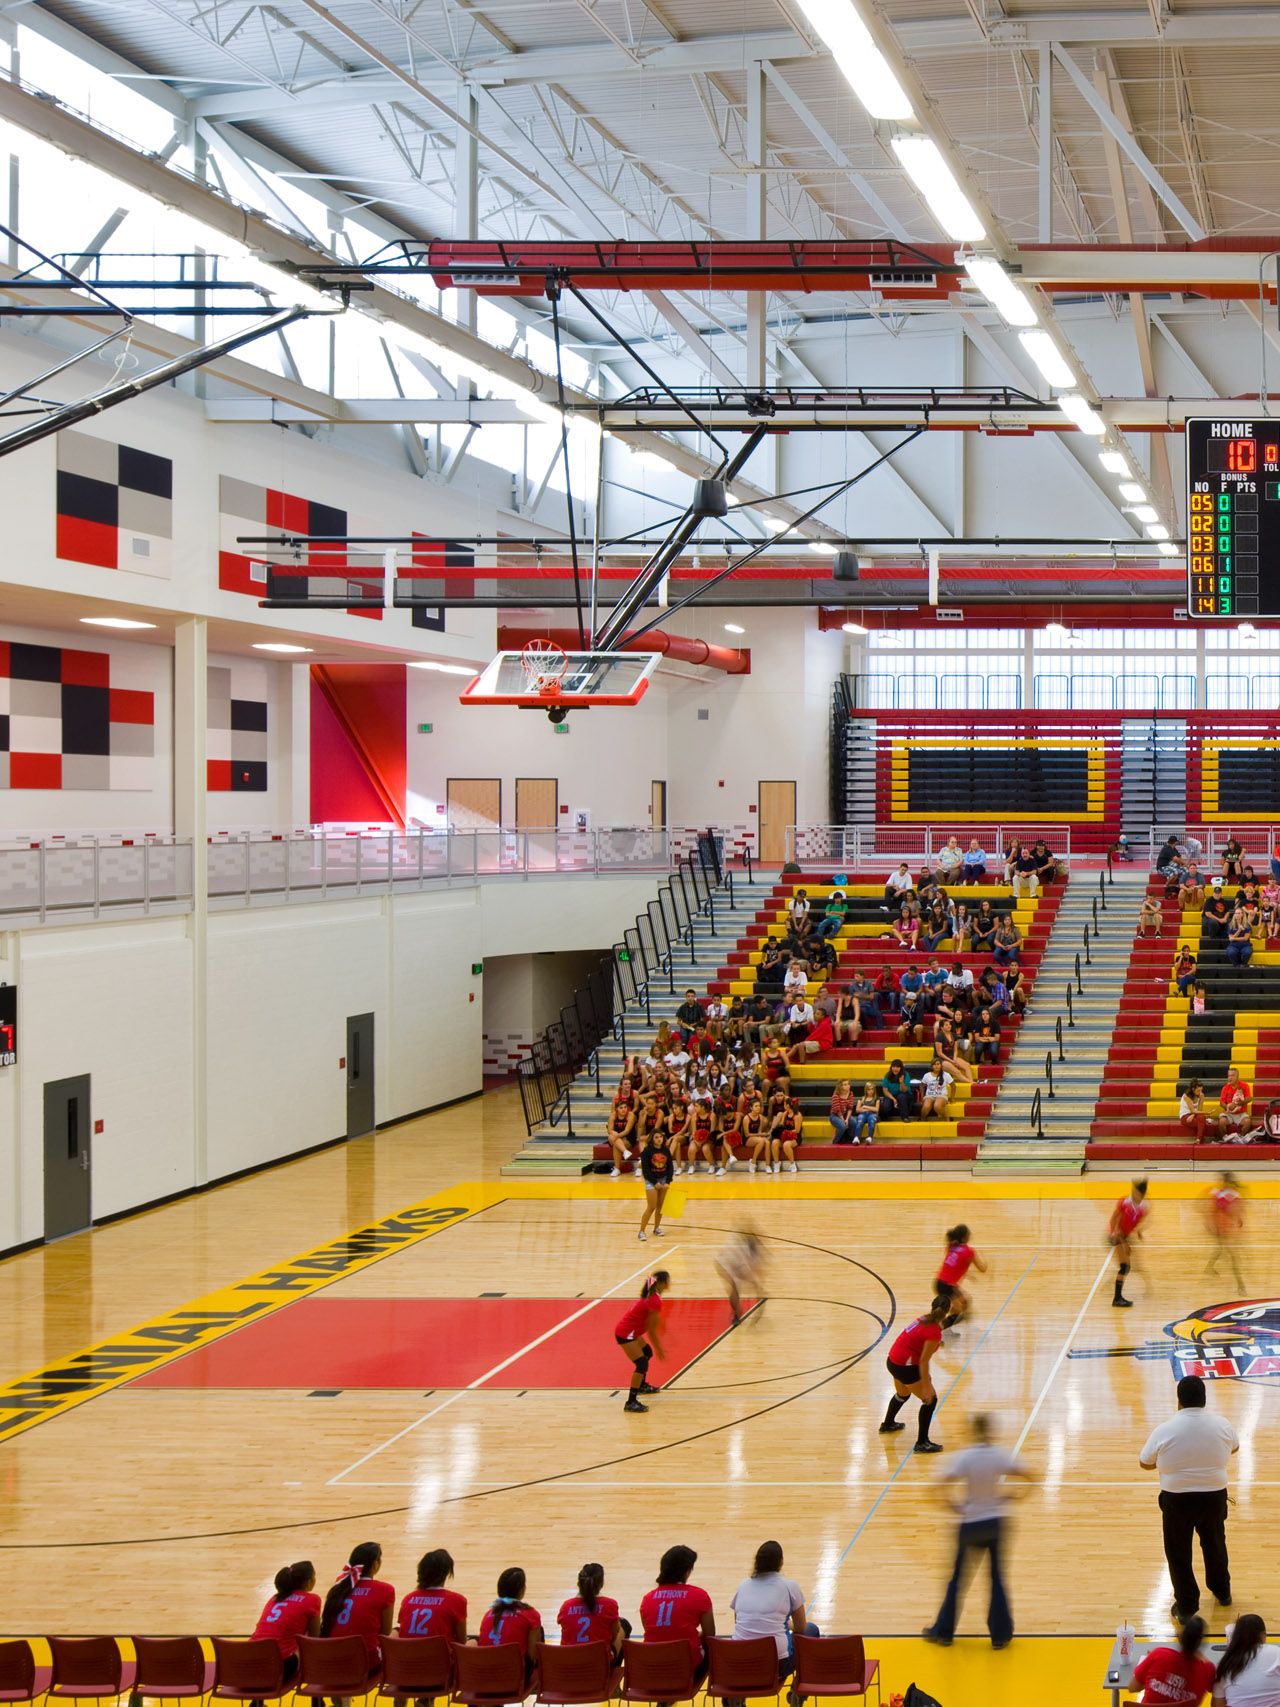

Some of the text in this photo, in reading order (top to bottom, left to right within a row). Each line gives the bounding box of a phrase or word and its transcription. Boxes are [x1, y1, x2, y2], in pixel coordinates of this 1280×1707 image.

[1211, 423, 1253, 437] HOME
[1229, 441, 1254, 470] 10
[1266, 445, 1277, 462] 0
[1264, 464, 1279, 472] TOL
[1221, 473, 1248, 481] BONUS
[1195, 482, 1256, 493] NO F PTS
[1192, 495, 1229, 511] 05 0
[1192, 516, 1229, 532] 02 0
[1192, 537, 1229, 552] 03 0
[1192, 557, 1213, 573] 06
[1198, 578, 1230, 593] 11 0
[1198, 598, 1230, 613] 14 3
[234, 1206, 470, 1292] HAWKS
[408, 1596, 445, 1606] ANTHONY
[653, 1589, 689, 1600] ANTHONY
[266, 1602, 288, 1622] 5
[655, 1600, 674, 1627] 11
[408, 1608, 433, 1635] 12
[576, 1616, 591, 1642] 2
